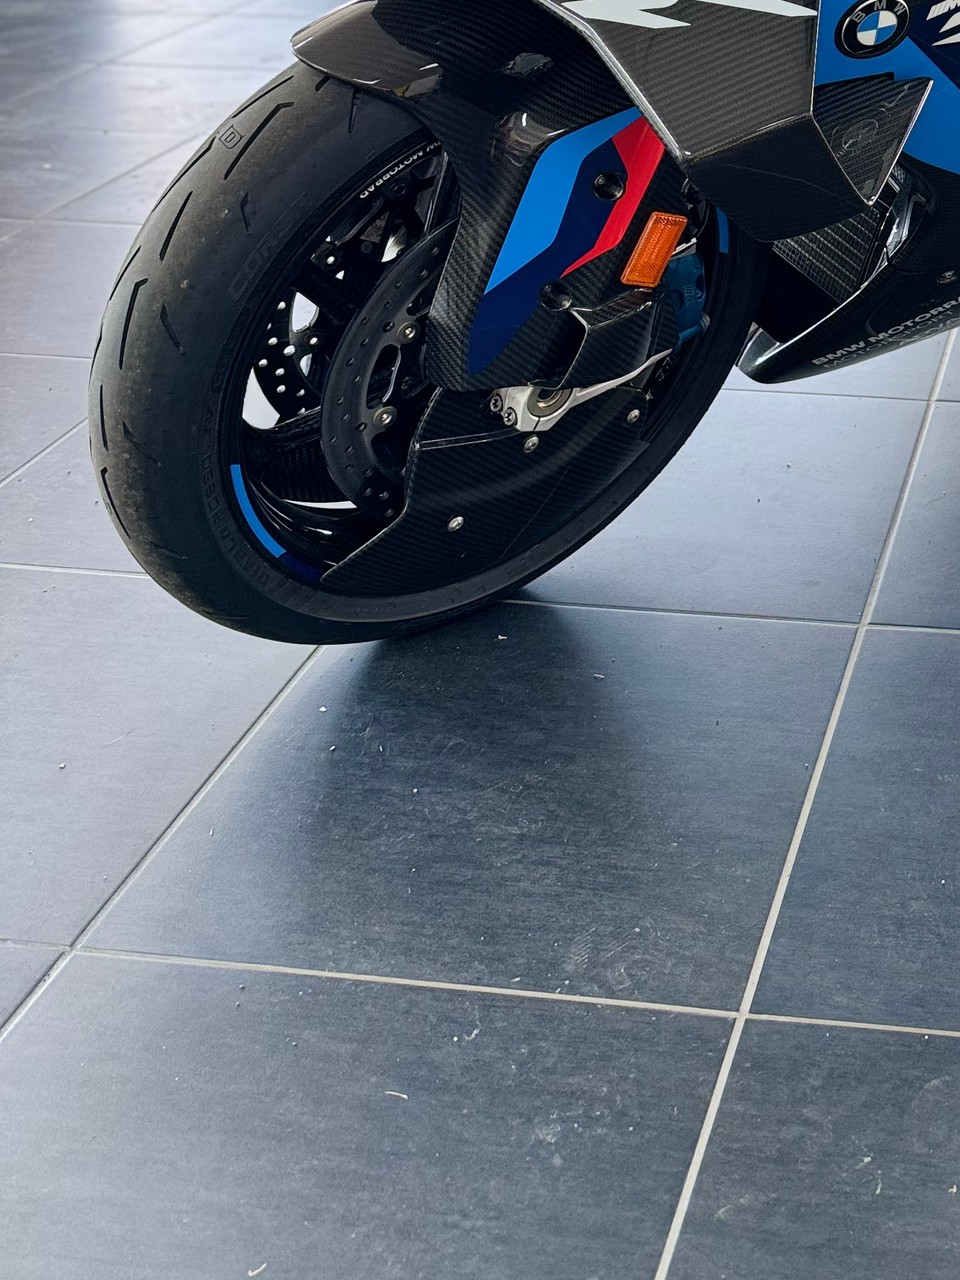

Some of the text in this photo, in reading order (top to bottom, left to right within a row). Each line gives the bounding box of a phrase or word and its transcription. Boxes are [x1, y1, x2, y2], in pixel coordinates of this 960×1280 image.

[851, 0, 906, 23] BMW
[359, 150, 424, 199] MOTORRAD
[812, 340, 866, 366] BMW
